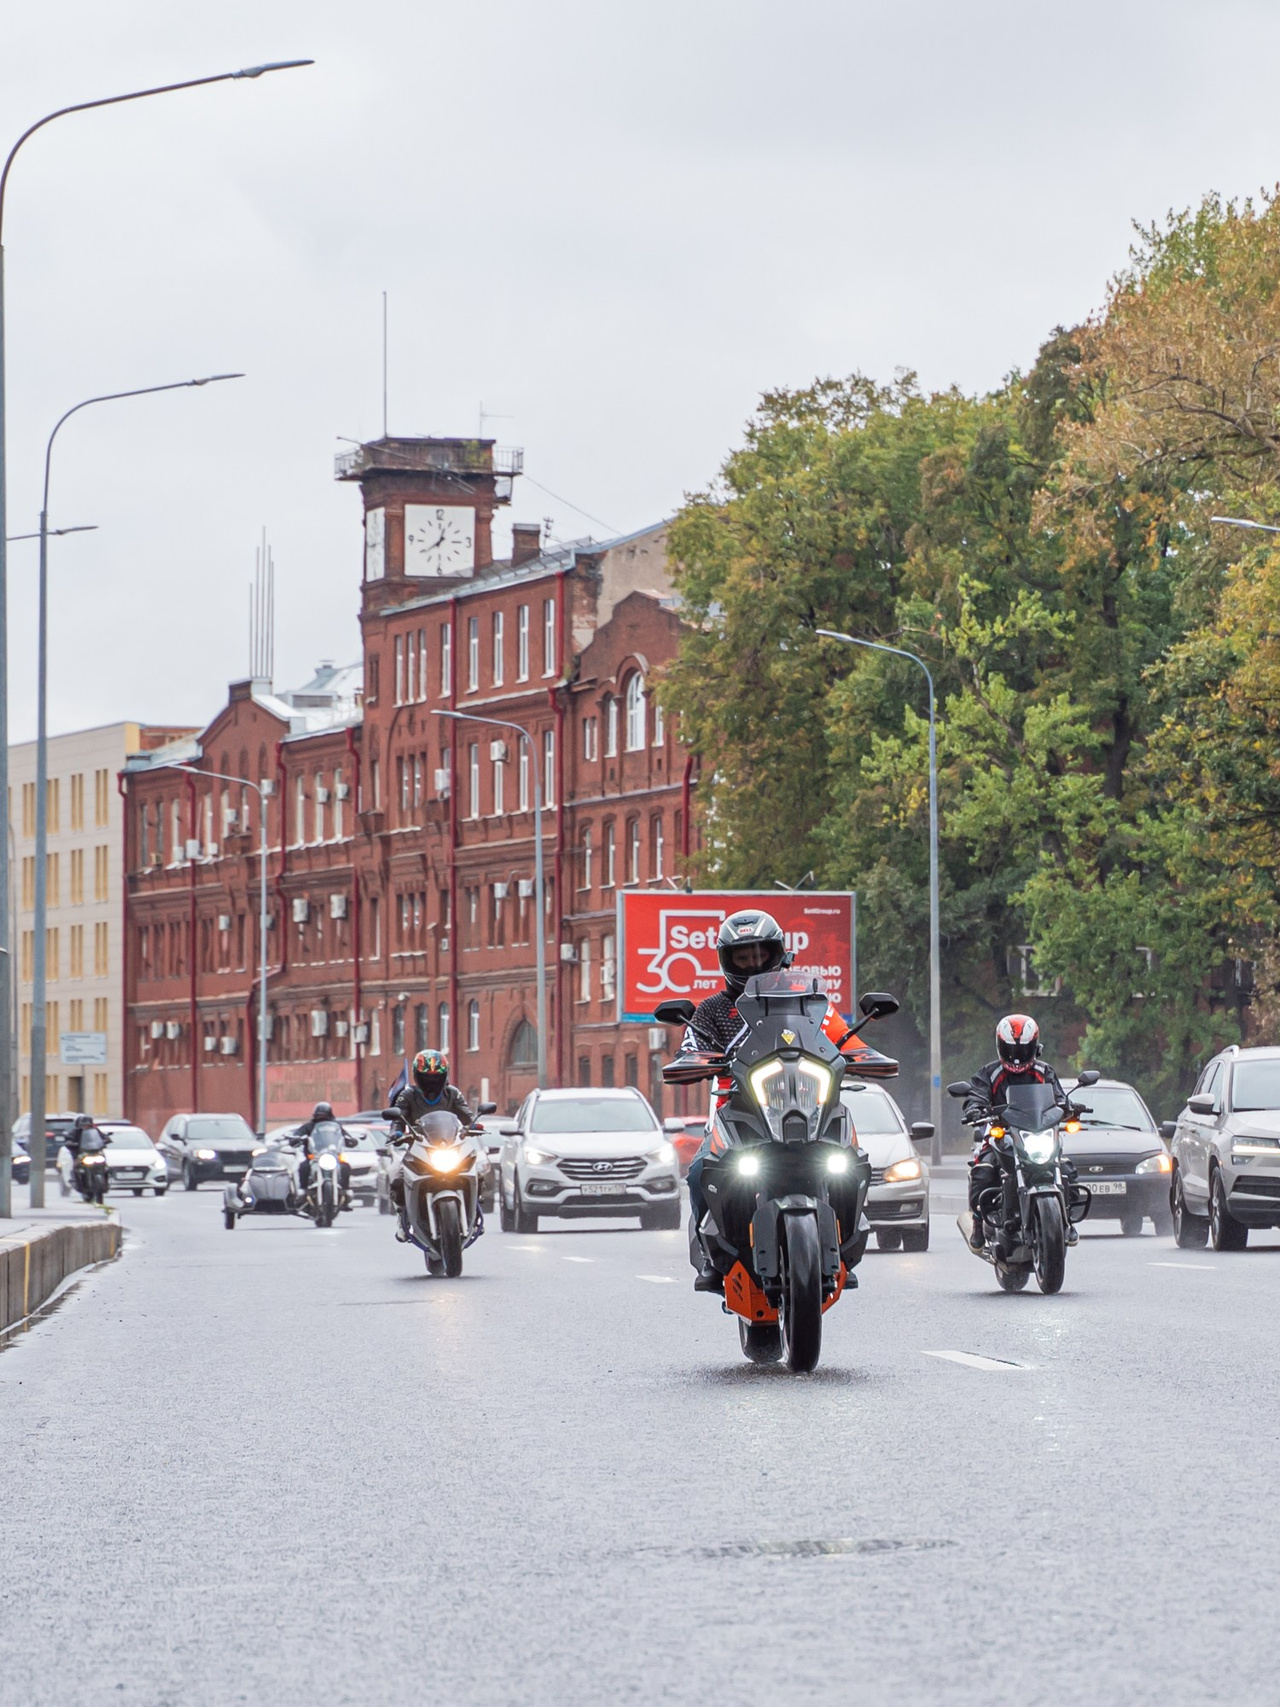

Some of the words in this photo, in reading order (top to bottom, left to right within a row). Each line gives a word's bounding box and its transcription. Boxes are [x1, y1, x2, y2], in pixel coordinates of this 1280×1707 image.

[465, 537, 472, 548] 3
[669, 925, 719, 950] Set
[692, 979, 718, 989] лет
